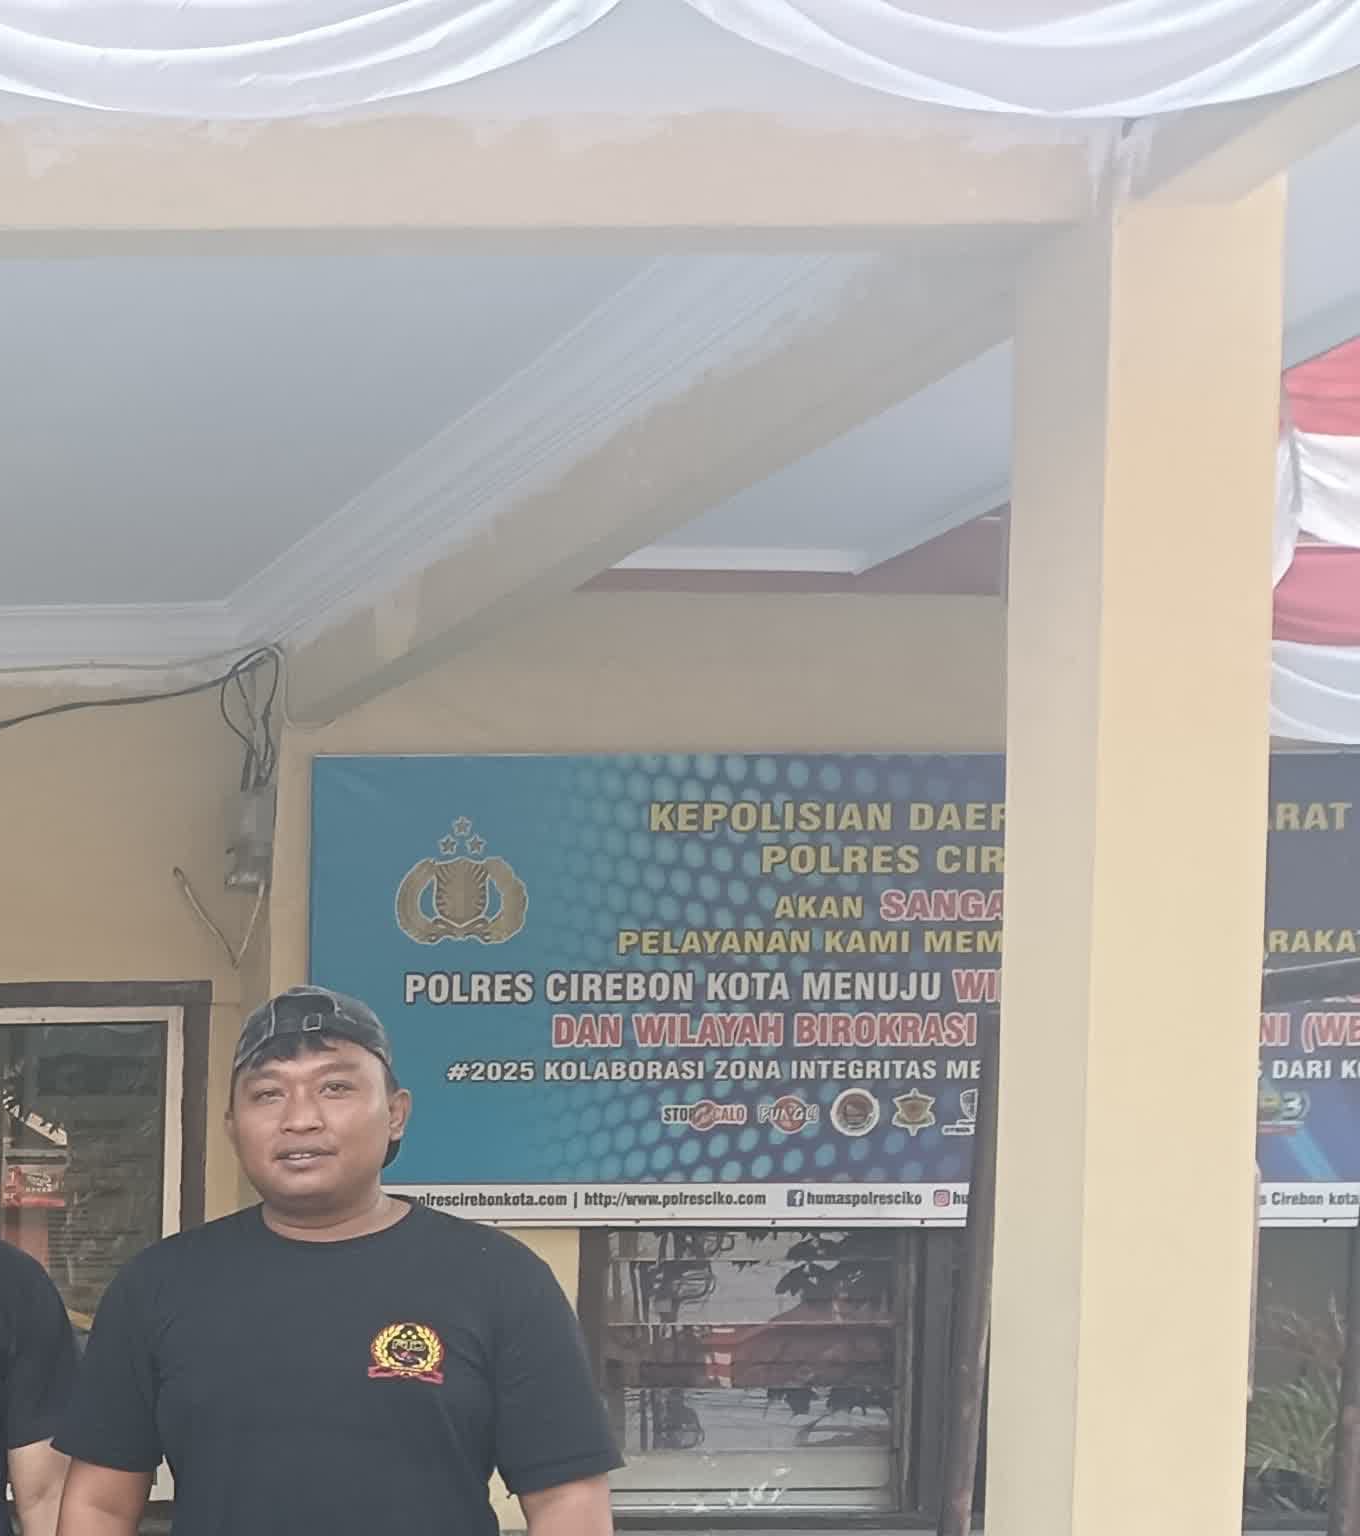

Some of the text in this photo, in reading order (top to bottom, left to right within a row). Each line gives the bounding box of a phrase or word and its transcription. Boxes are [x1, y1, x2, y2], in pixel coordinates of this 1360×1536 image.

[648, 802, 892, 832] KEPOLISIAN
[1269, 802, 1353, 831] RAT
[760, 845, 920, 874] POLRES
[774, 895, 864, 919] AKAN
[618, 930, 811, 954] PELAYANAN
[824, 930, 910, 953] KAMI
[405, 968, 1001, 1003] POLRES CIREBON KOTA MENUJU WI
[552, 1013, 624, 1048] DAN
[632, 1012, 784, 1048] WILAYAH
[793, 1011, 978, 1047] BIROKRASI
[446, 1061, 535, 1082] #2025
[543, 1060, 705, 1081] KOLABORASI
[714, 1060, 782, 1080] ZONA
[790, 1059, 938, 1080] INTEGRITAS
[1271, 1059, 1333, 1079] DARI
[1340, 1059, 1360, 1079] K
[1271, 1191, 1325, 1206] Cirebon
